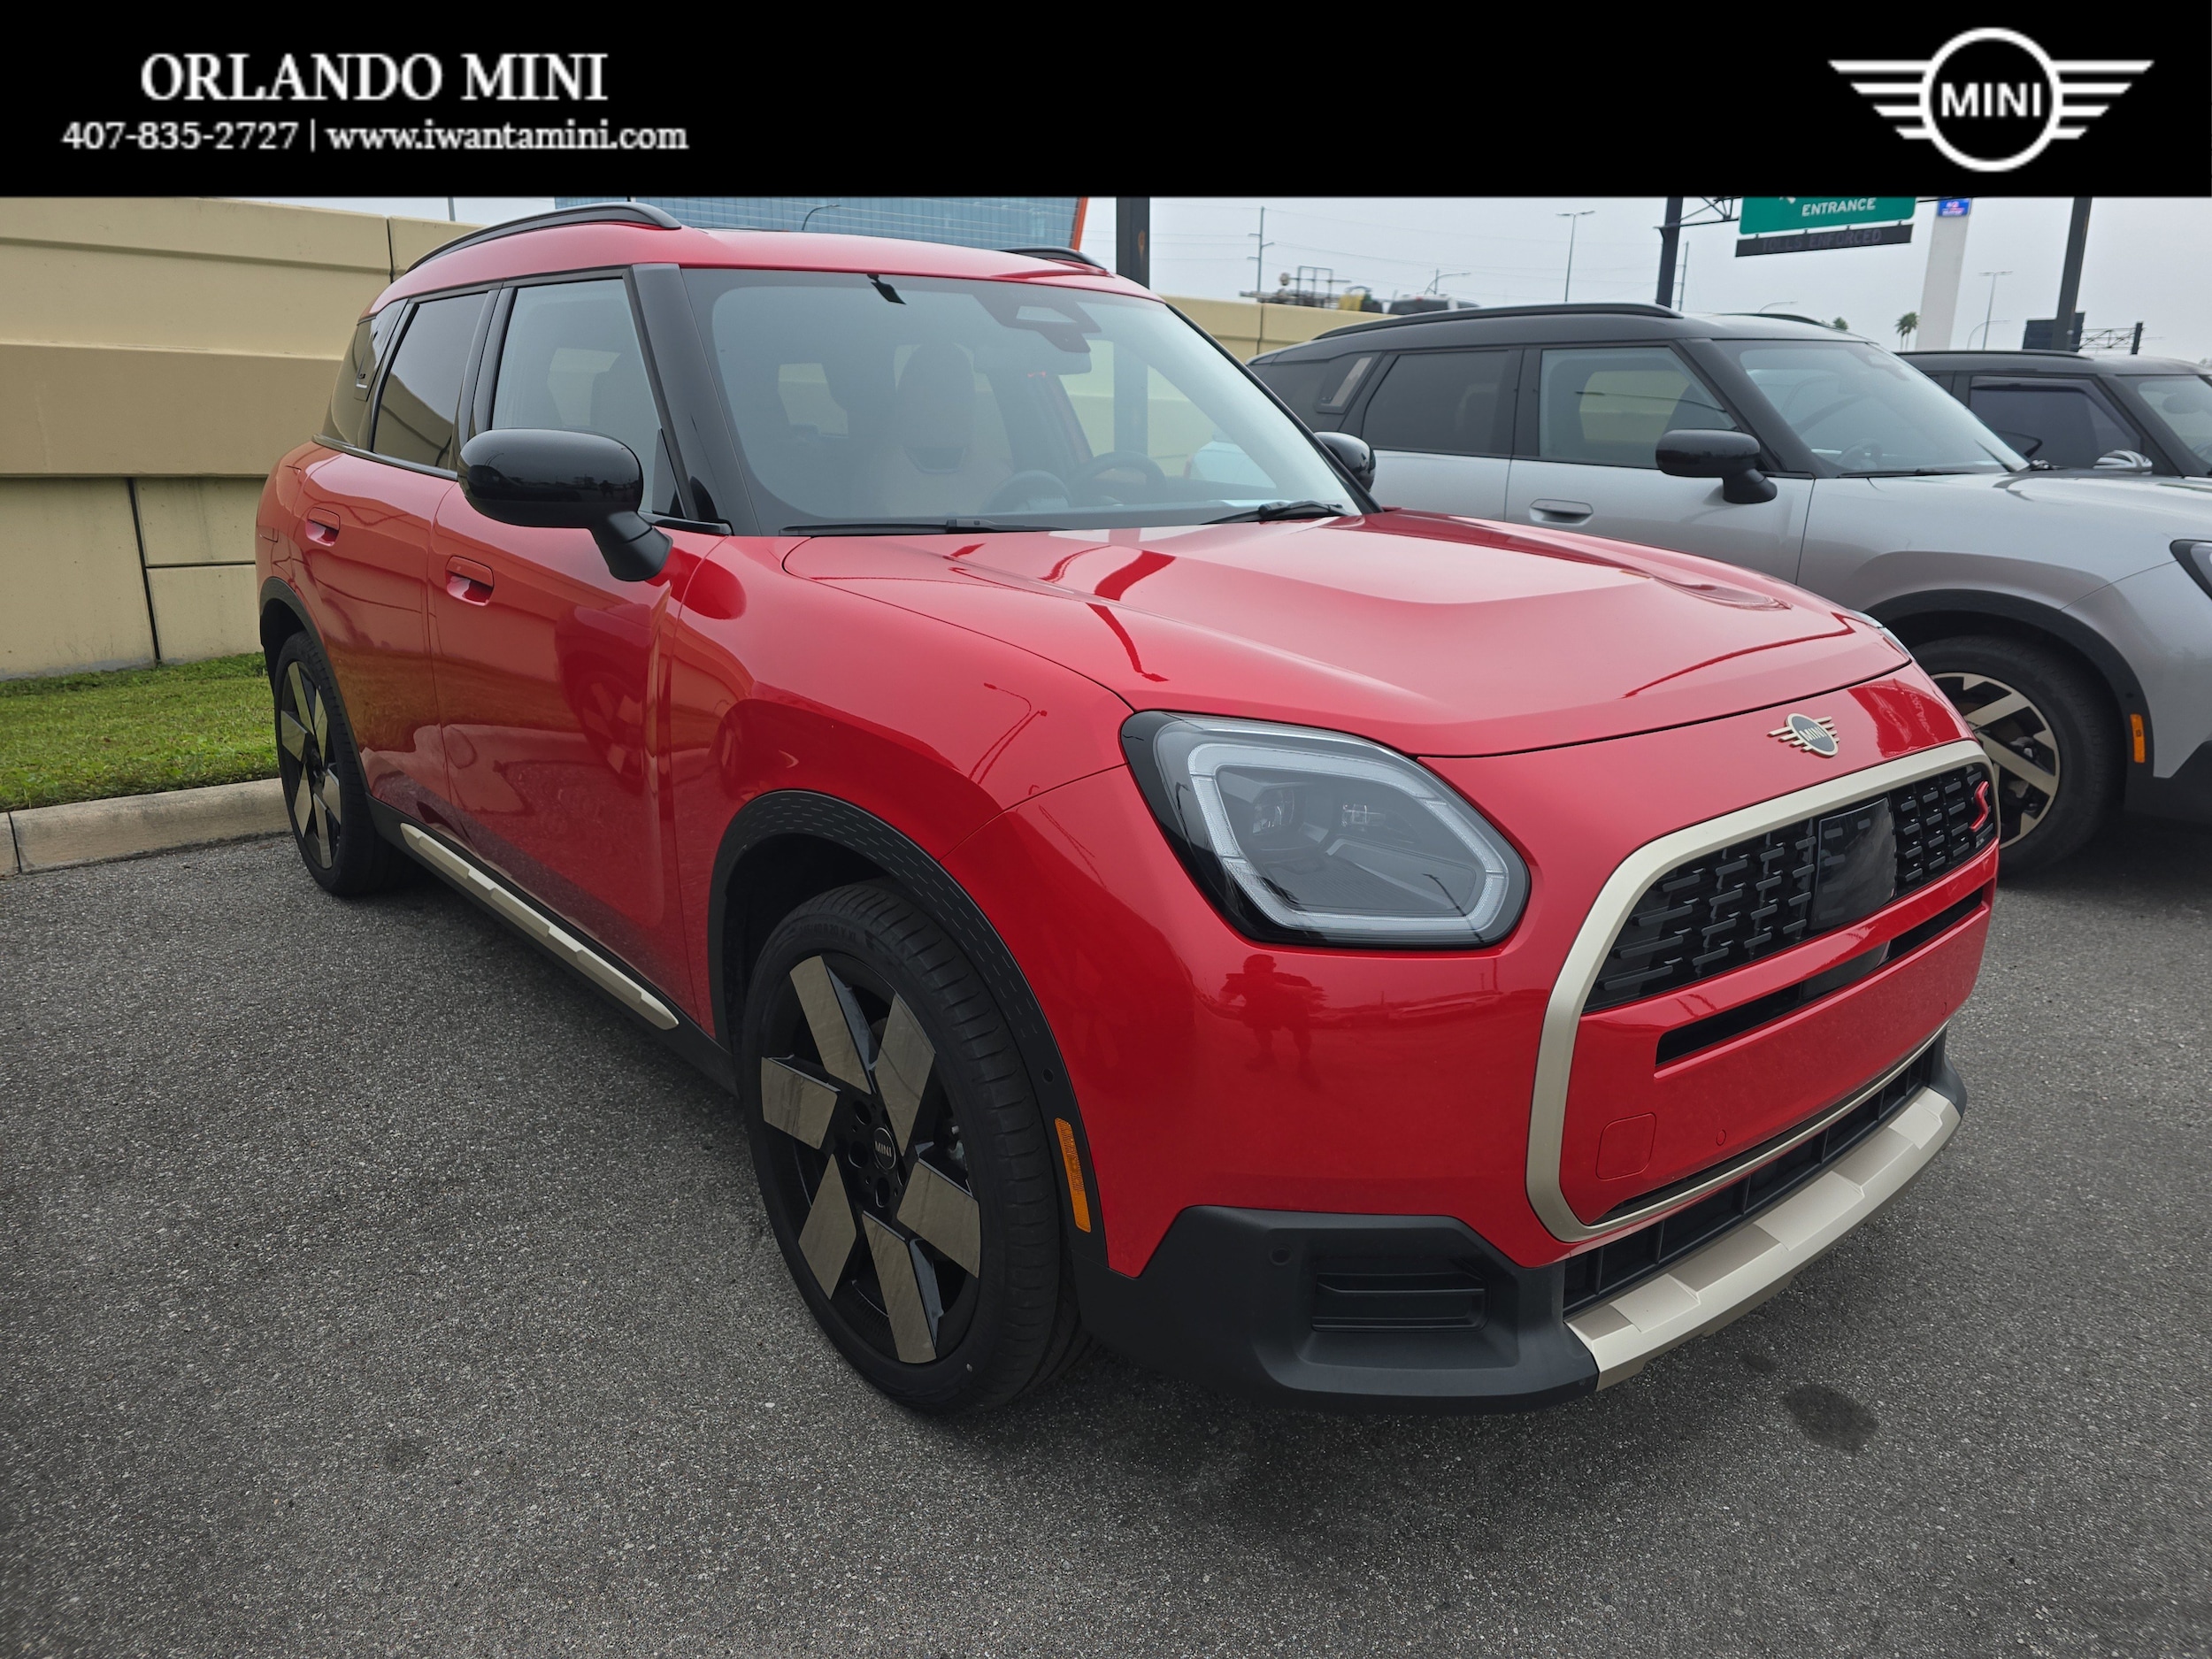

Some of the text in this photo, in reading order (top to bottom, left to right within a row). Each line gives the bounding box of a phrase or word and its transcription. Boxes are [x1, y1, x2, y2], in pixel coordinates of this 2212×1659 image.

[1801, 197, 1877, 217] ENTRANCE
[1762, 228, 1882, 252] TOLLS ENFORCED
[1799, 726, 1827, 741] MINI
[874, 1141, 892, 1158] MINI
